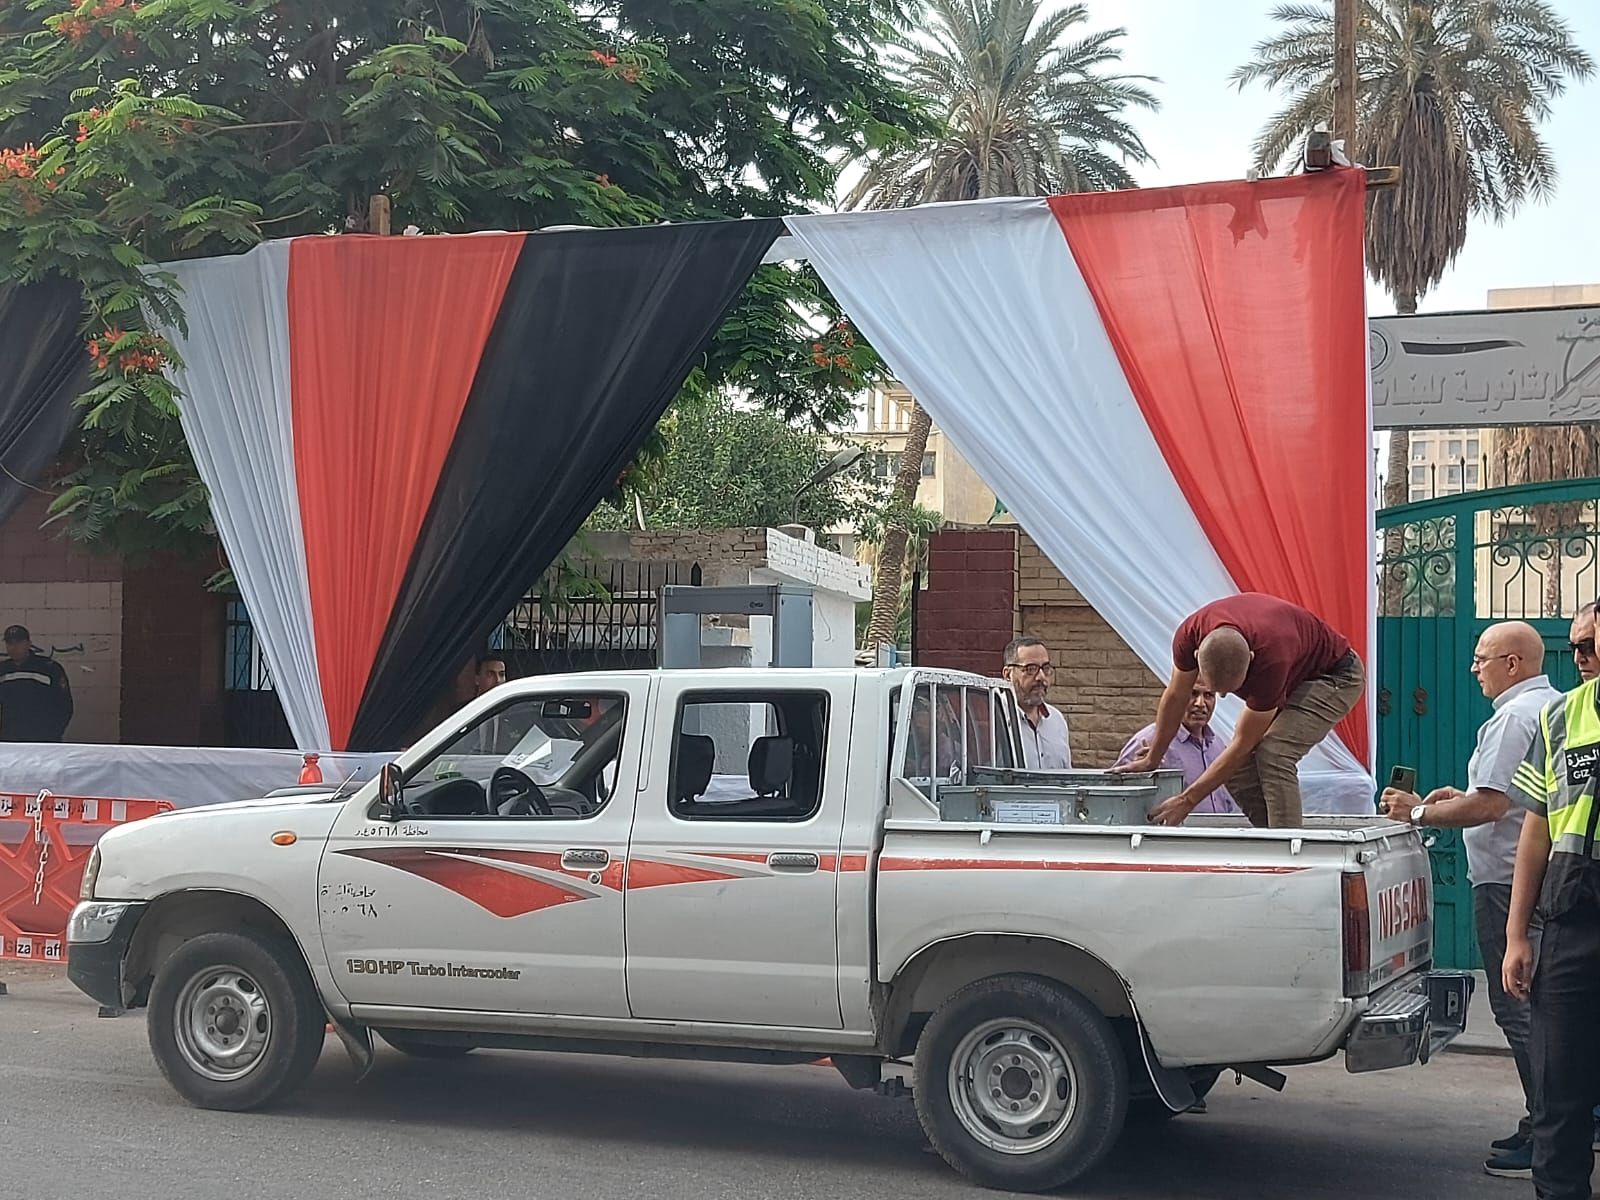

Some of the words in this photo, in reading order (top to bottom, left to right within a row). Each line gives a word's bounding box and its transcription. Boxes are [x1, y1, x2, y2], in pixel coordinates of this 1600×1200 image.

[1566, 748, 1600, 768] الجيزة
[1573, 767, 1595, 780] GIZ
[1376, 876, 1427, 942] NISSAN
[33, 941, 66, 958] Traffi
[406, 961, 446, 977] Turbo
[446, 962, 521, 980] Intercooler
